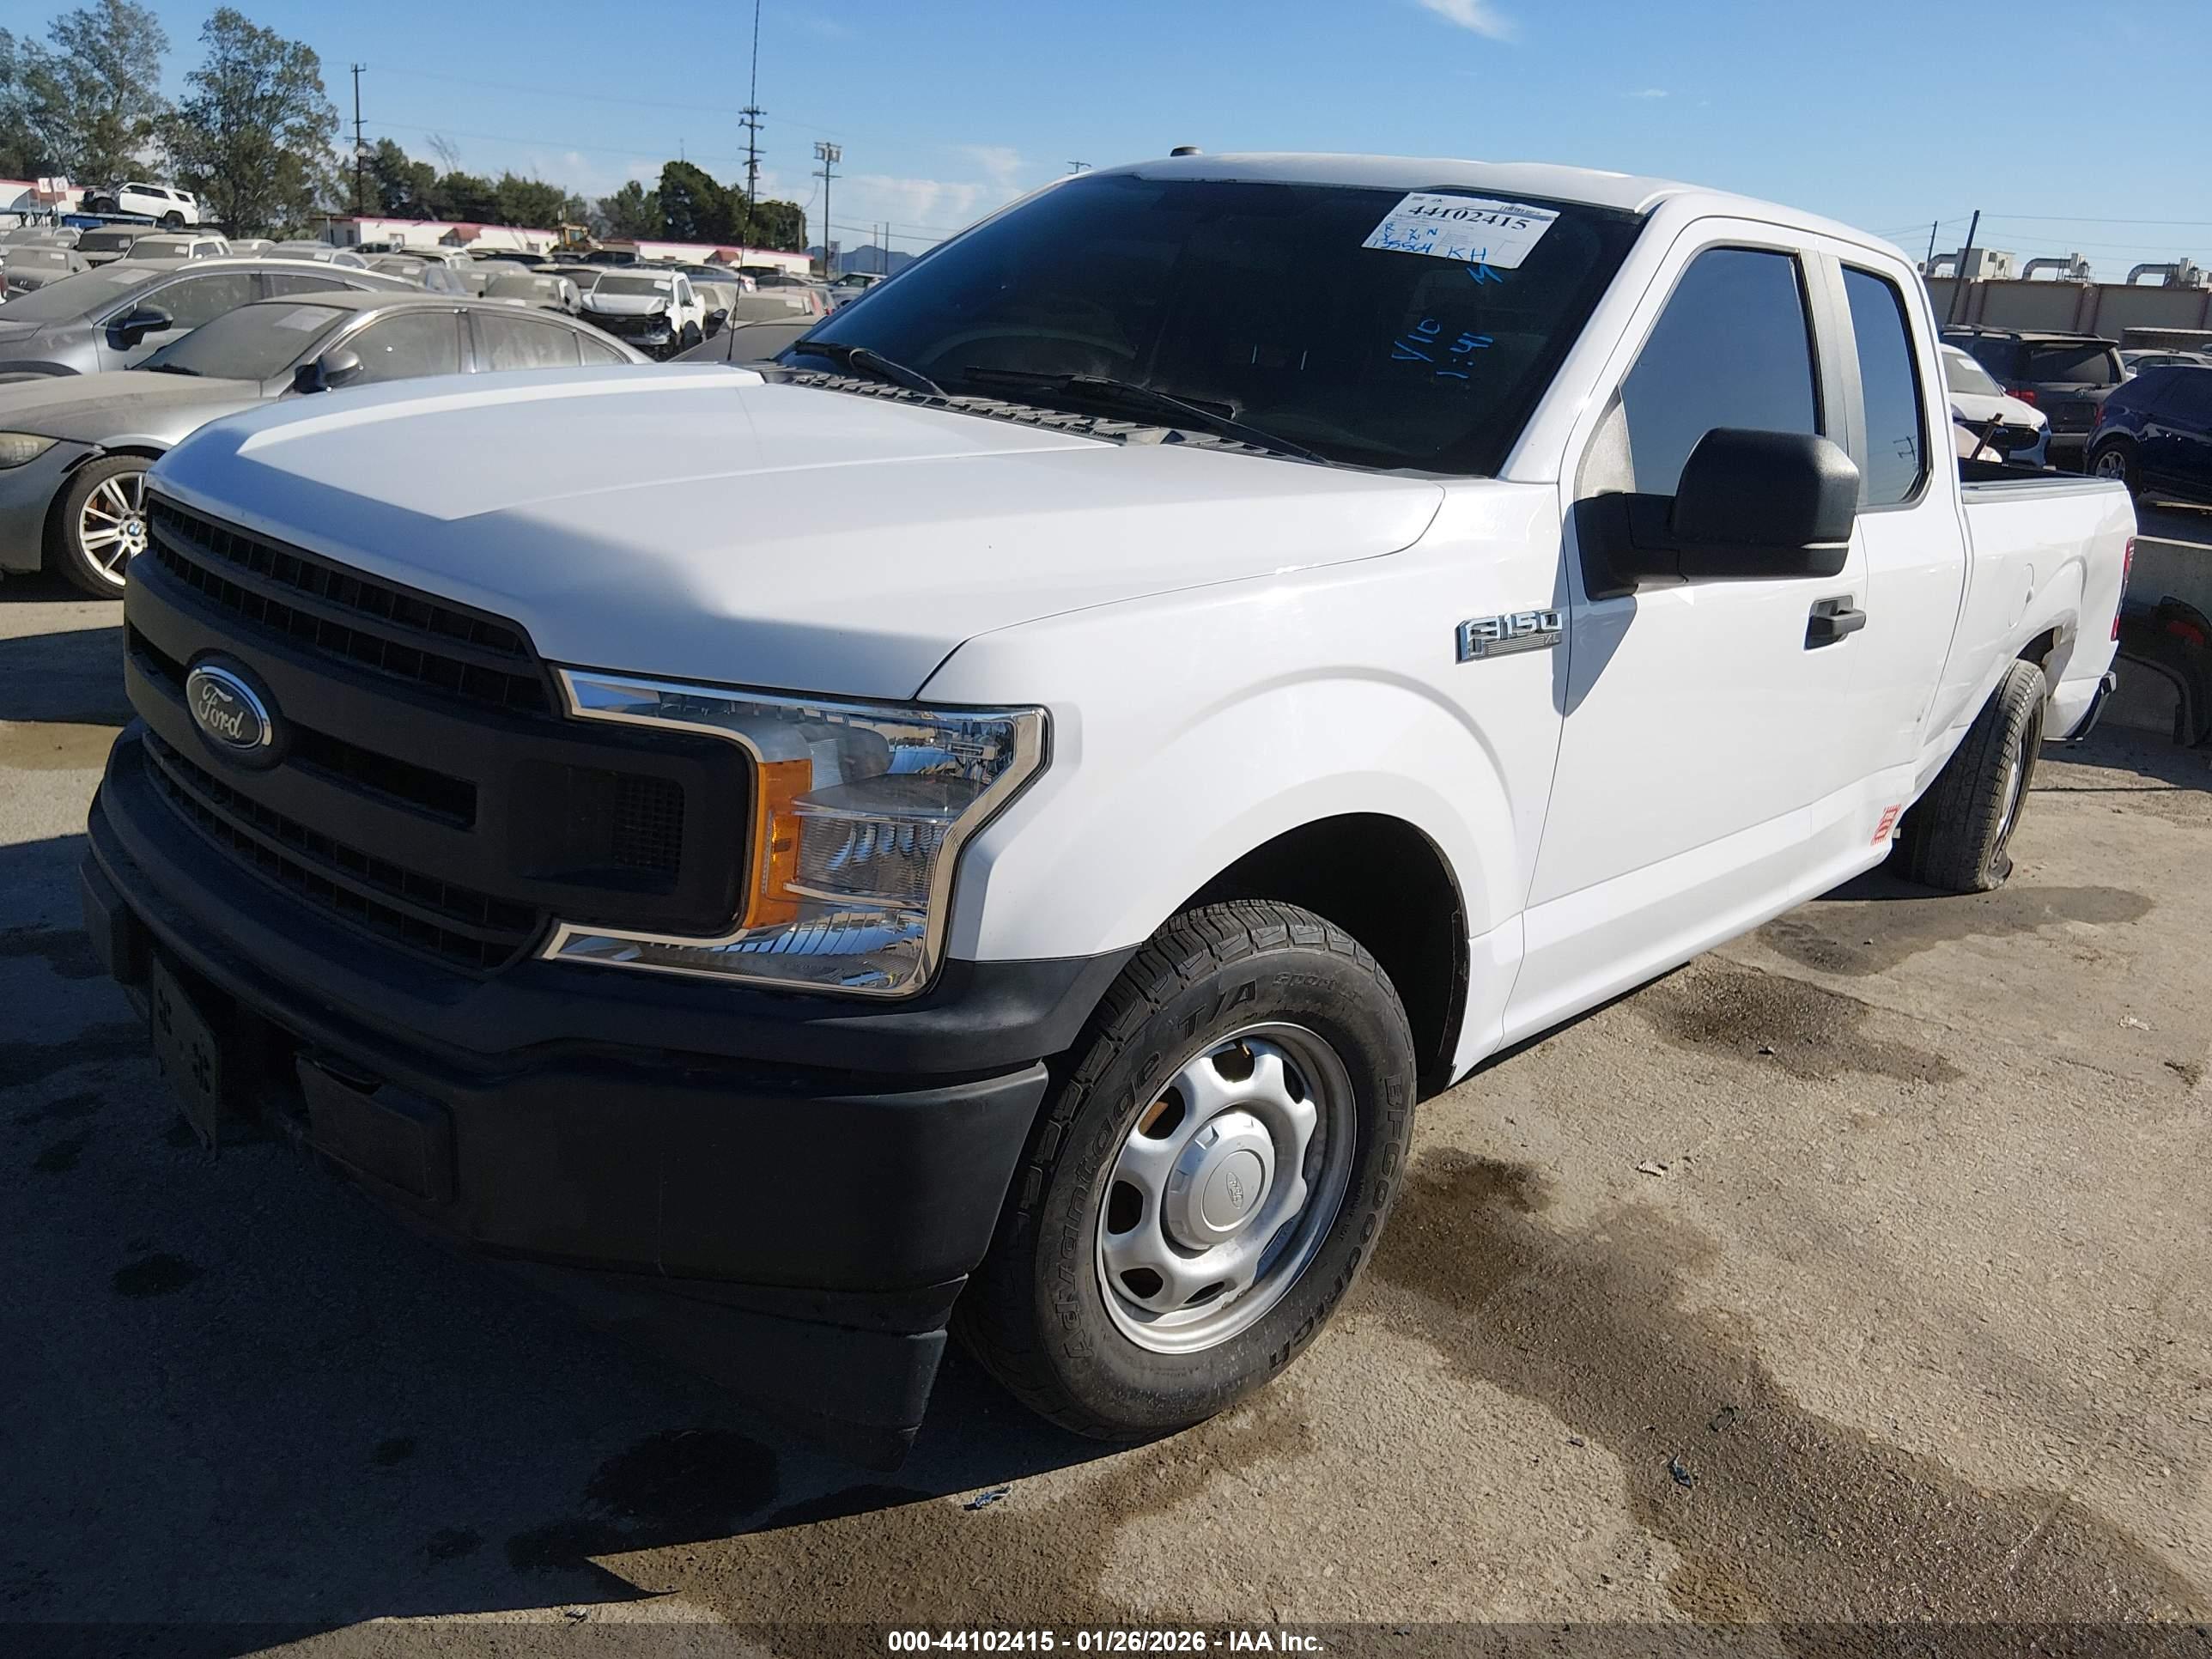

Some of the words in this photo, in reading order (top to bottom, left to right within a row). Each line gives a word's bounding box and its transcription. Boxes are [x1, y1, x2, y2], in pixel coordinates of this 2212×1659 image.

[1407, 204, 1531, 231] 44102415
[198, 683, 245, 739] Ford
[1054, 1051, 1161, 1359] Advantage
[1177, 978, 1257, 1041] T/A
[1267, 1074, 1406, 1370] BFGoodrich
